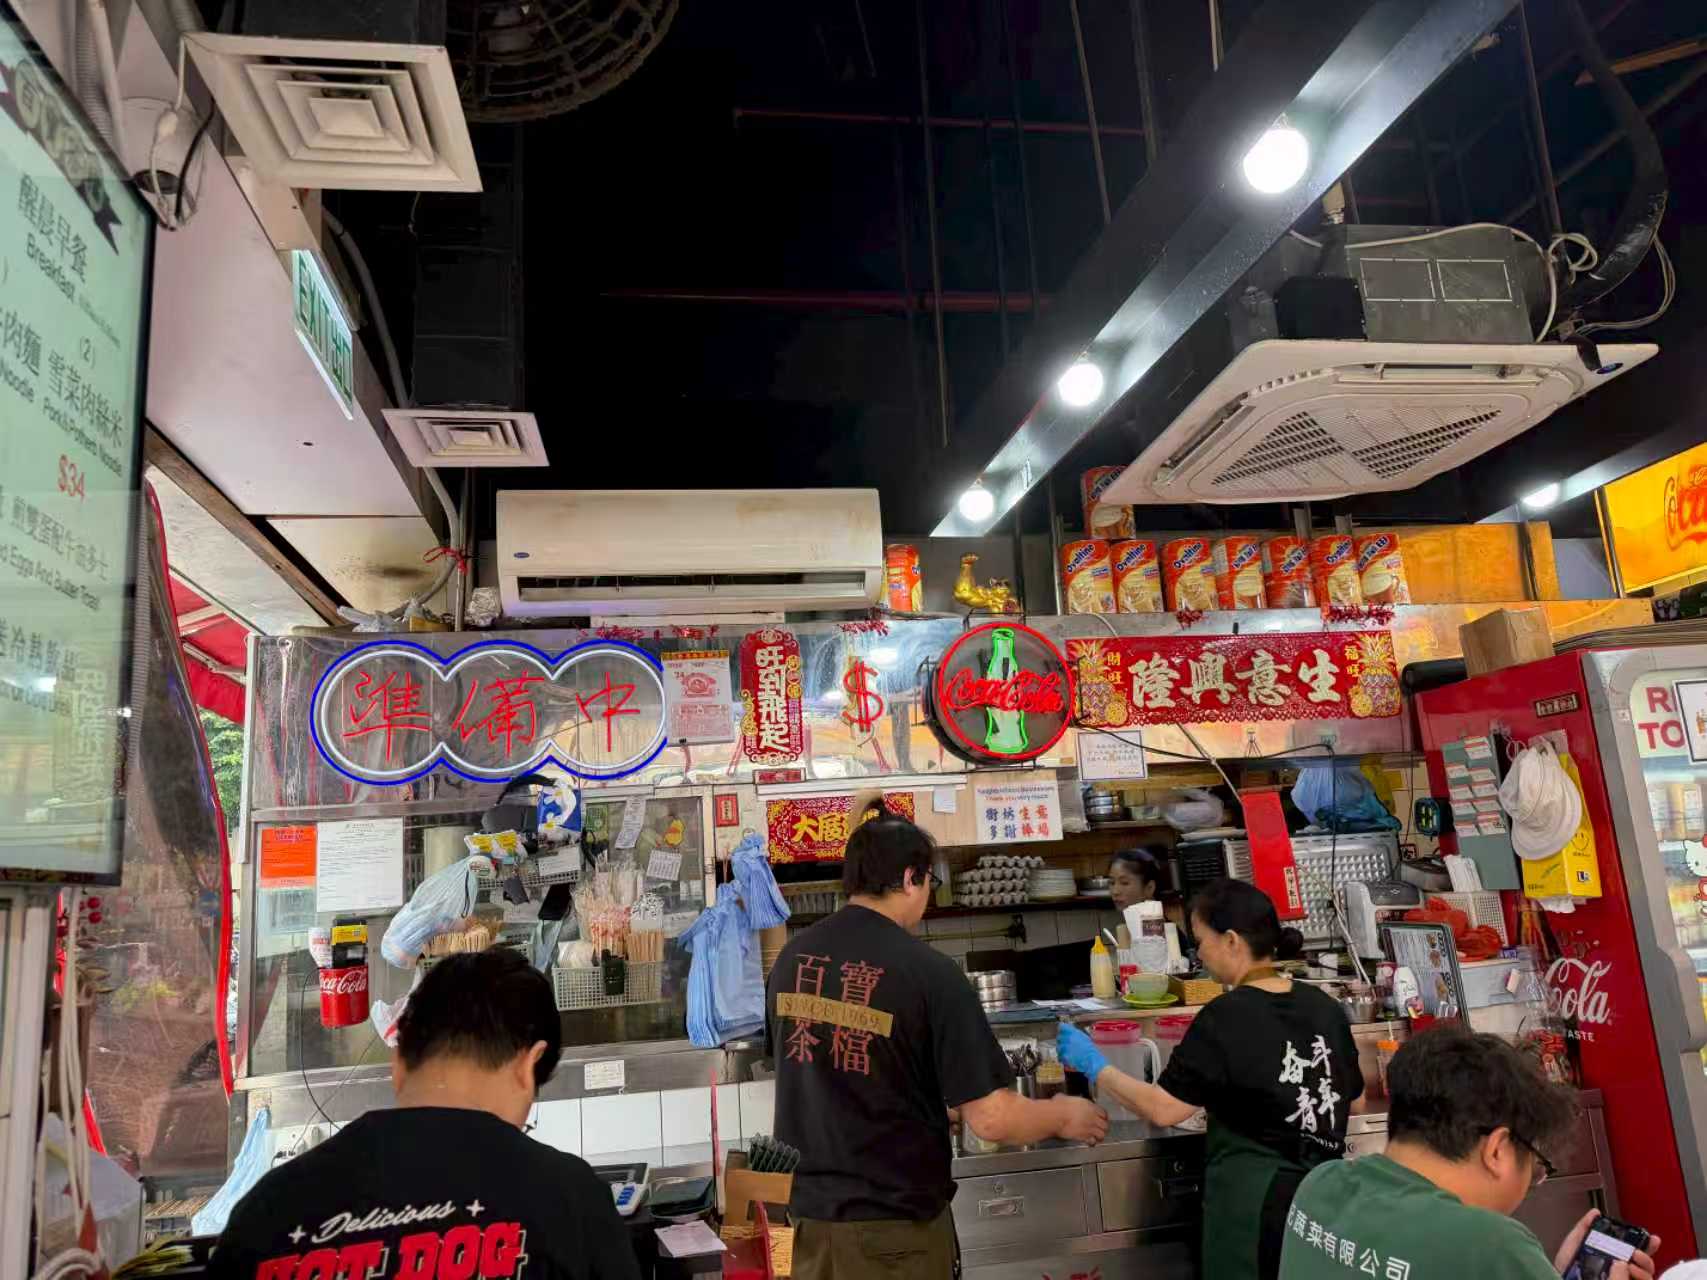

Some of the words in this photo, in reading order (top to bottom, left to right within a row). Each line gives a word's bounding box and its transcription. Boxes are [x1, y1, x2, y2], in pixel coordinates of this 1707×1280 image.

[27, 232, 75, 303] Breakfast
[298, 252, 330, 364] EXIT
[0, 307, 42, 377] 肉麵
[58, 453, 87, 501] $34
[1066, 543, 1095, 573] Ovaltine
[1116, 543, 1146, 572] Ovaltine
[342, 671, 641, 762] 準備中
[755, 645, 790, 753] 旺到飛起
[1645, 686, 1677, 713] R
[1567, 1029, 1595, 1042] ASTE
[311, 1200, 456, 1243] Delicious
[394, 1221, 529, 1280] DOG
